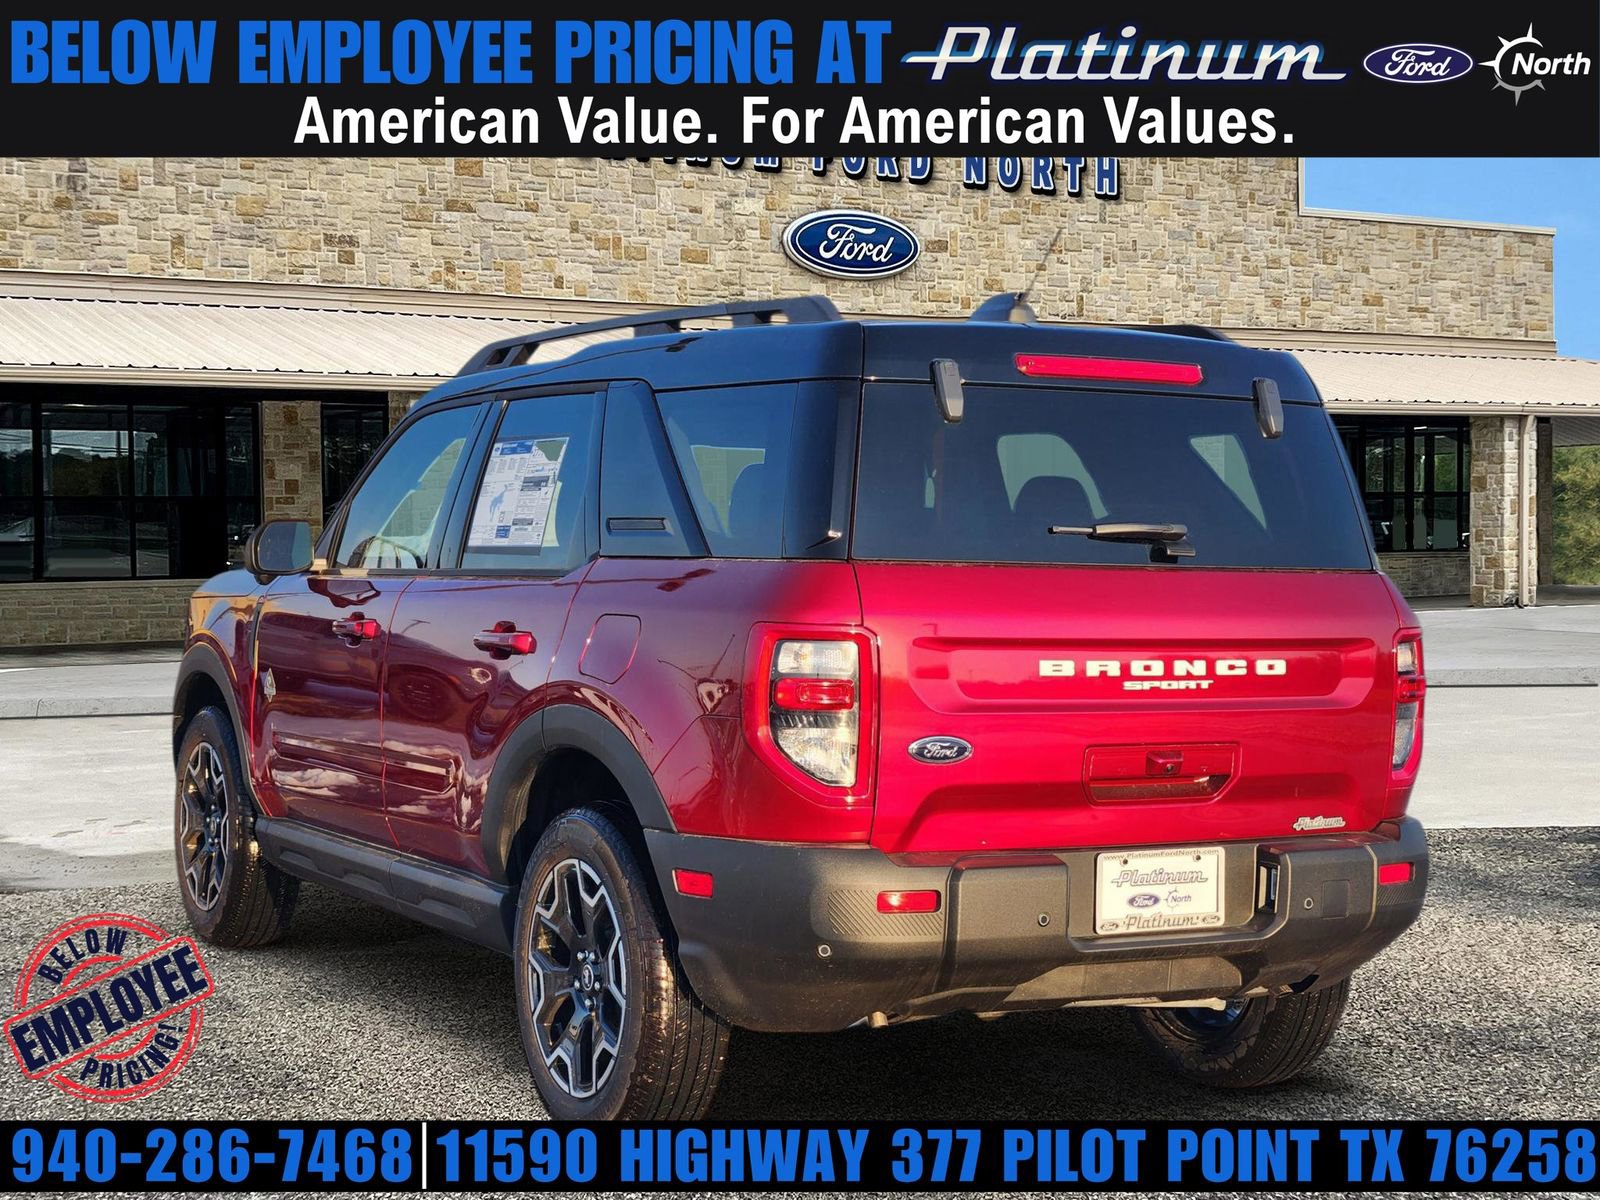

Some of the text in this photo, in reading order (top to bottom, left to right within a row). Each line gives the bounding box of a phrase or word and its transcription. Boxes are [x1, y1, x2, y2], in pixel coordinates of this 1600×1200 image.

[963, 157, 1118, 196] NORTH
[818, 222, 895, 264] Ford
[1038, 659, 1288, 677] BRONCO
[1122, 679, 1214, 692] SPORT
[923, 741, 959, 758] Ford
[1111, 867, 1209, 888] Platinum
[1132, 893, 1192, 906] Ford North
[1125, 912, 1199, 930] Platinum
